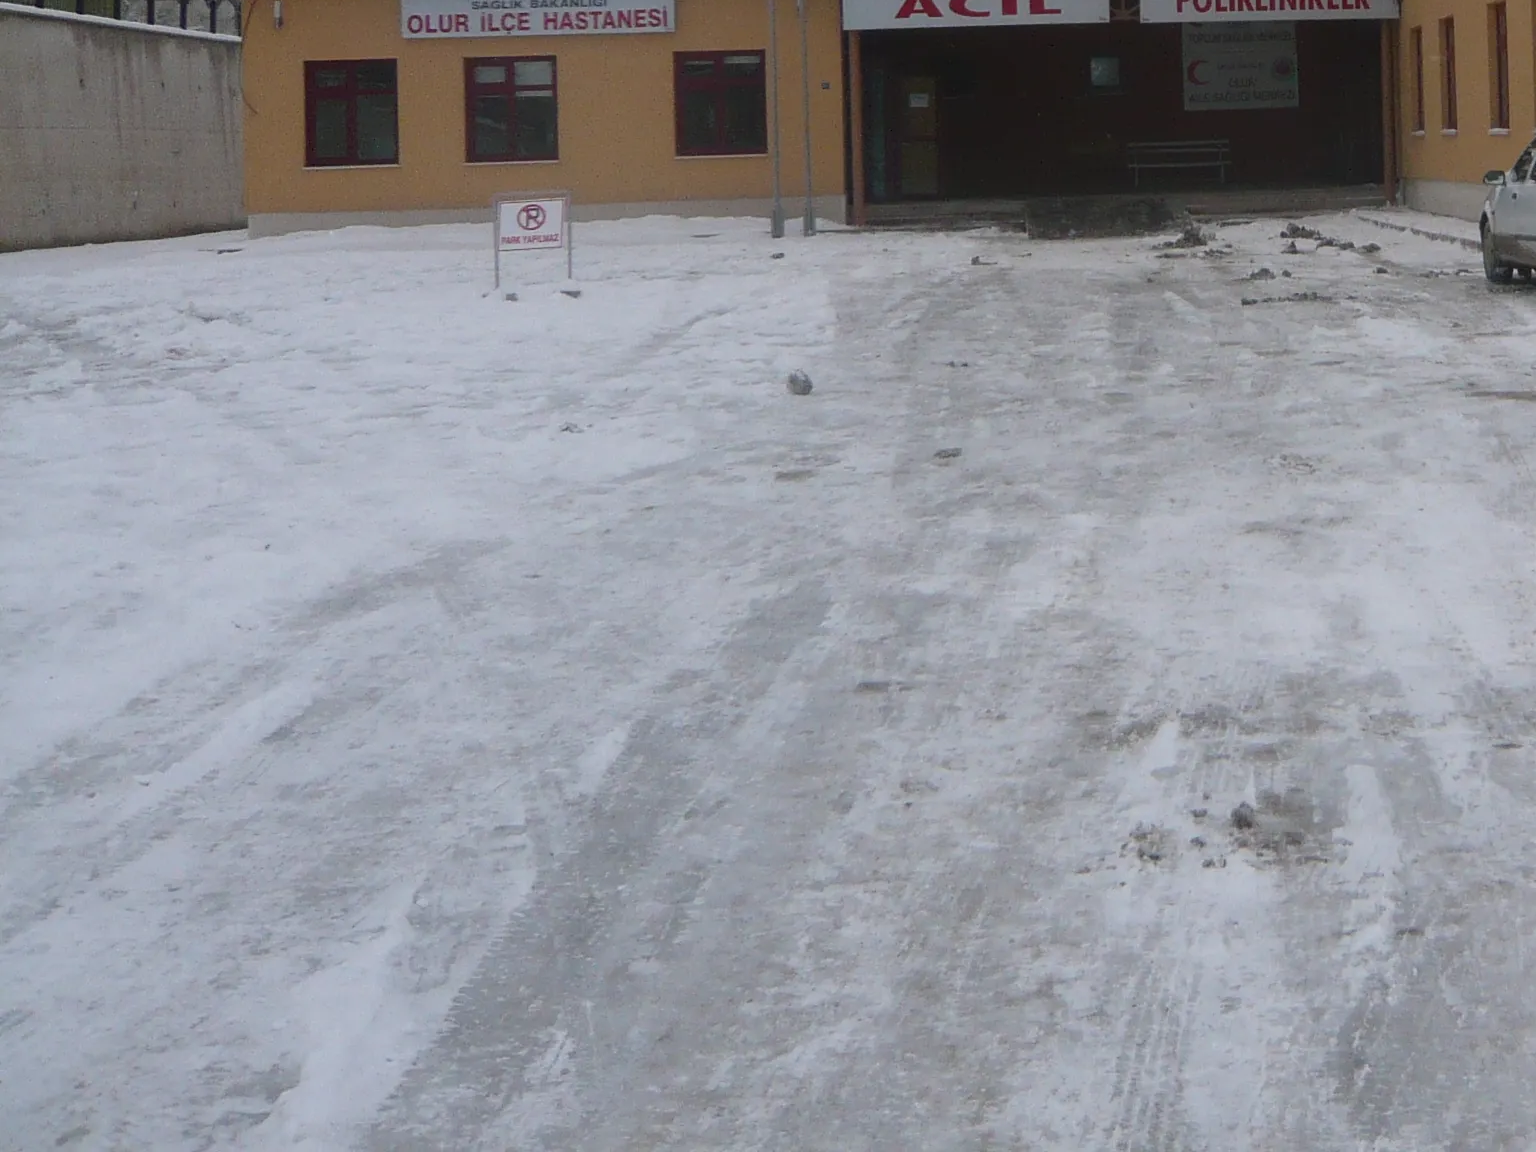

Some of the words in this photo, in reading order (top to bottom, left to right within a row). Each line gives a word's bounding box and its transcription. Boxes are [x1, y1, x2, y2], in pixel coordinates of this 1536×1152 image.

[407, 14, 469, 34] OLUR
[480, 12, 531, 35] İLÇE
[543, 5, 669, 30] HASTANESİ
[501, 235, 521, 245] PARK
[523, 233, 560, 244] YAPILMAZ
